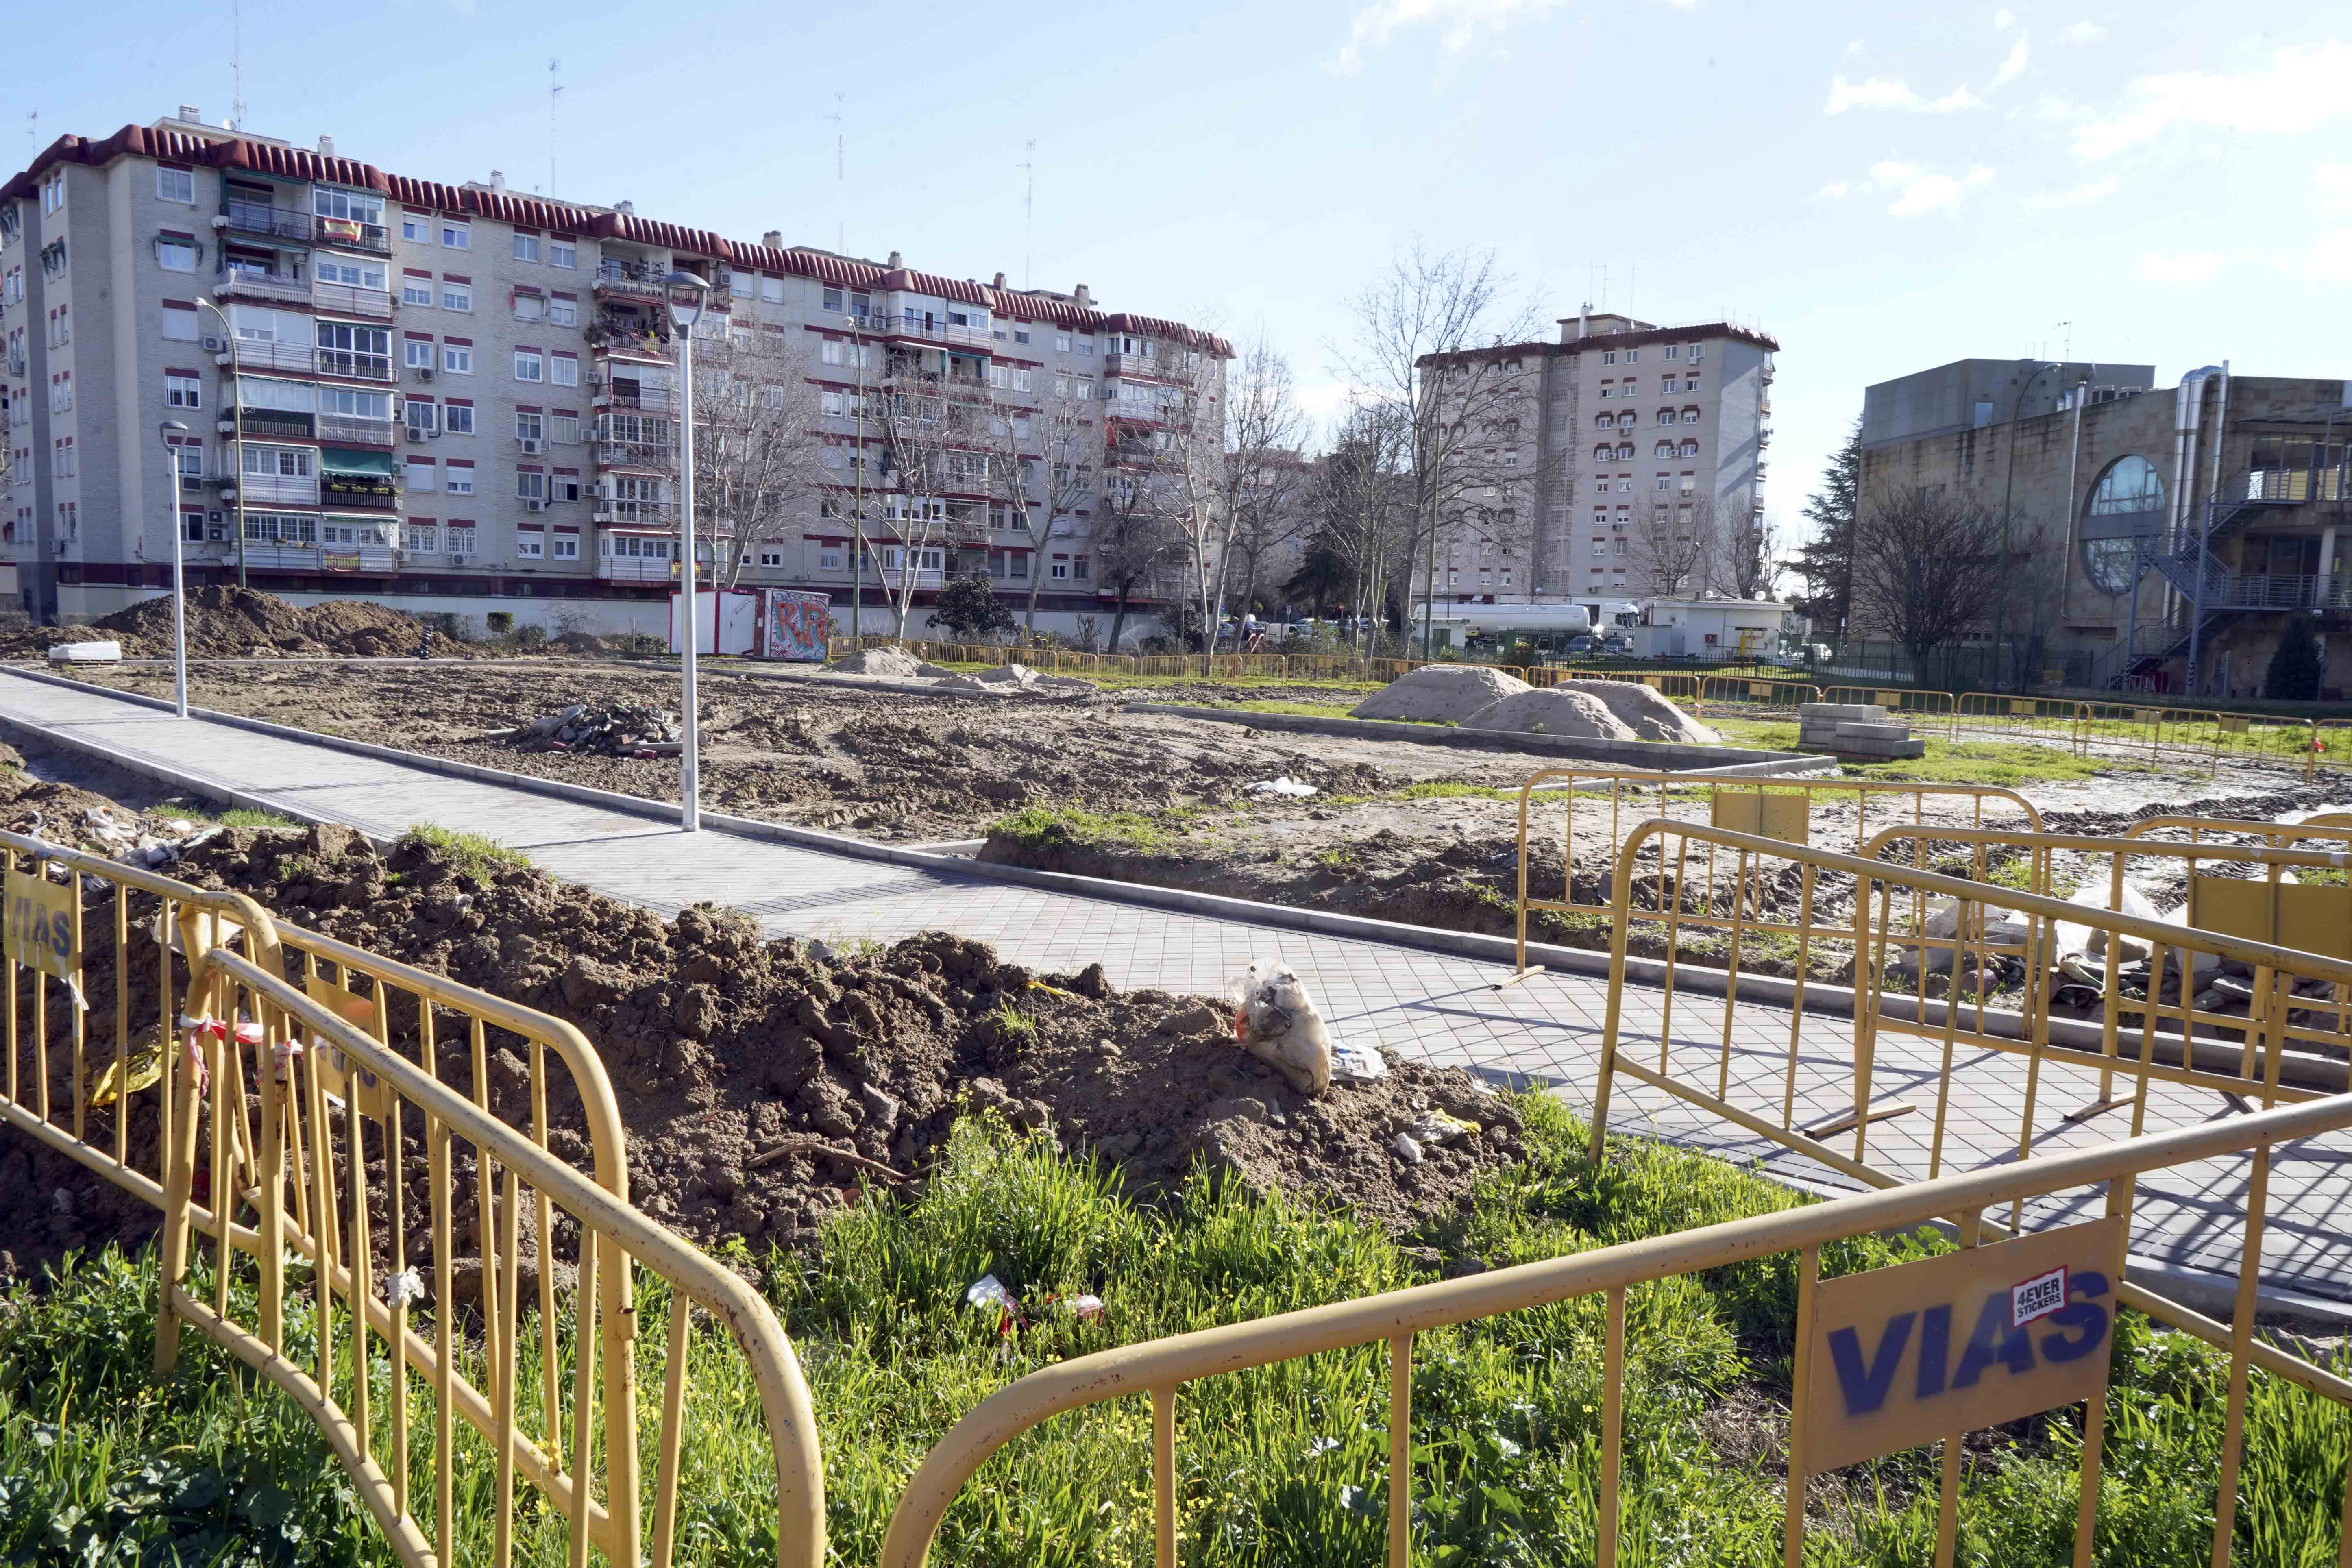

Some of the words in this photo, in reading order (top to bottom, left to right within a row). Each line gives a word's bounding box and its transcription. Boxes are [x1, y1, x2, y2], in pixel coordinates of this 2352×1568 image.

[4, 892, 70, 957] VIAS
[2017, 1278, 2060, 1305] 4EVER
[2017, 1293, 2061, 1318] STICKERS
[1827, 1271, 2109, 1416] VIAS
